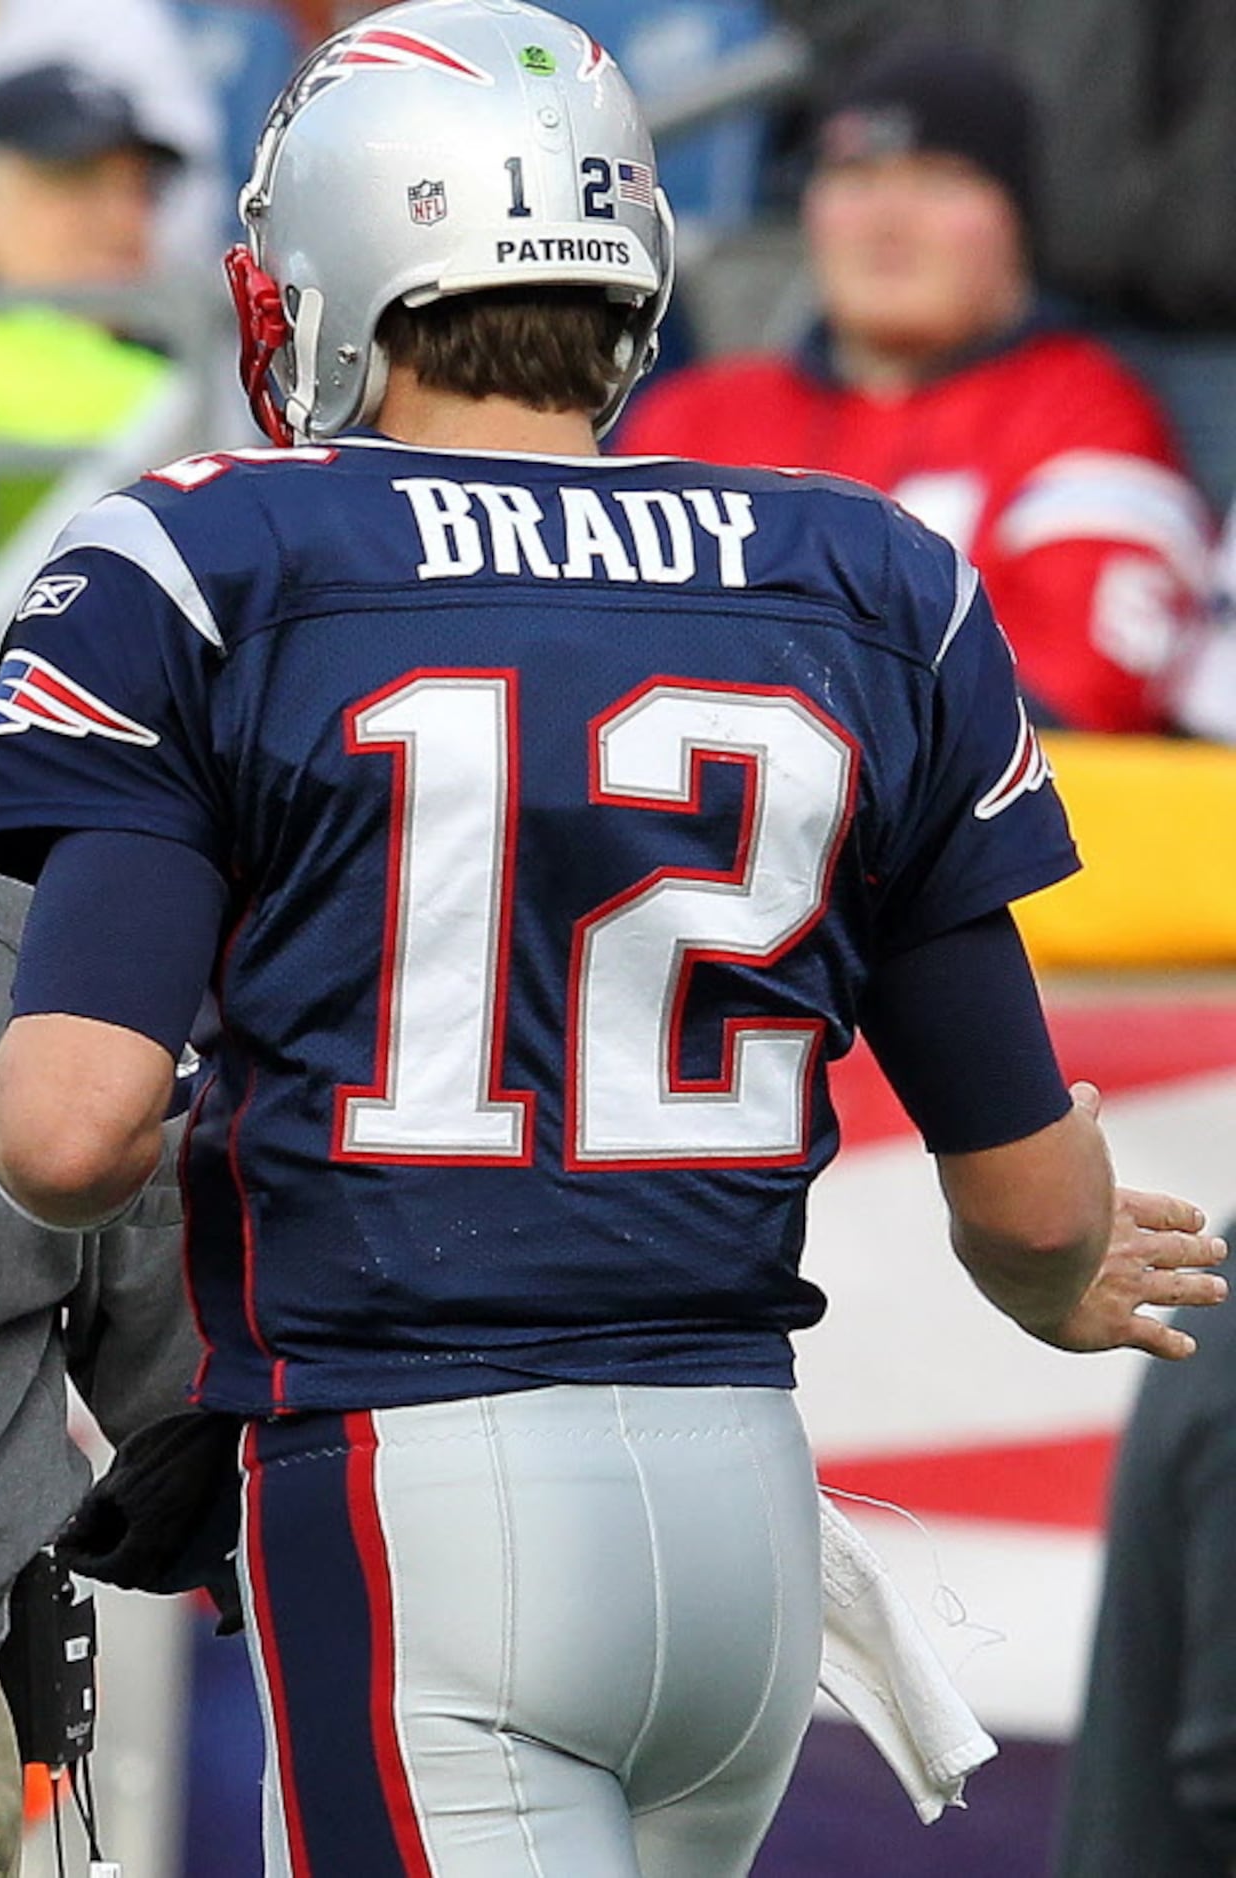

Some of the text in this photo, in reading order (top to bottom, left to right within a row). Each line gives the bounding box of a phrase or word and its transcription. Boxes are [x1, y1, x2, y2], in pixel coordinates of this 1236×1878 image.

[414, 198, 443, 220] NFL
[496, 239, 630, 264] PATRIOTS
[390, 477, 758, 589] BRADY
[331, 667, 859, 1171] 12
